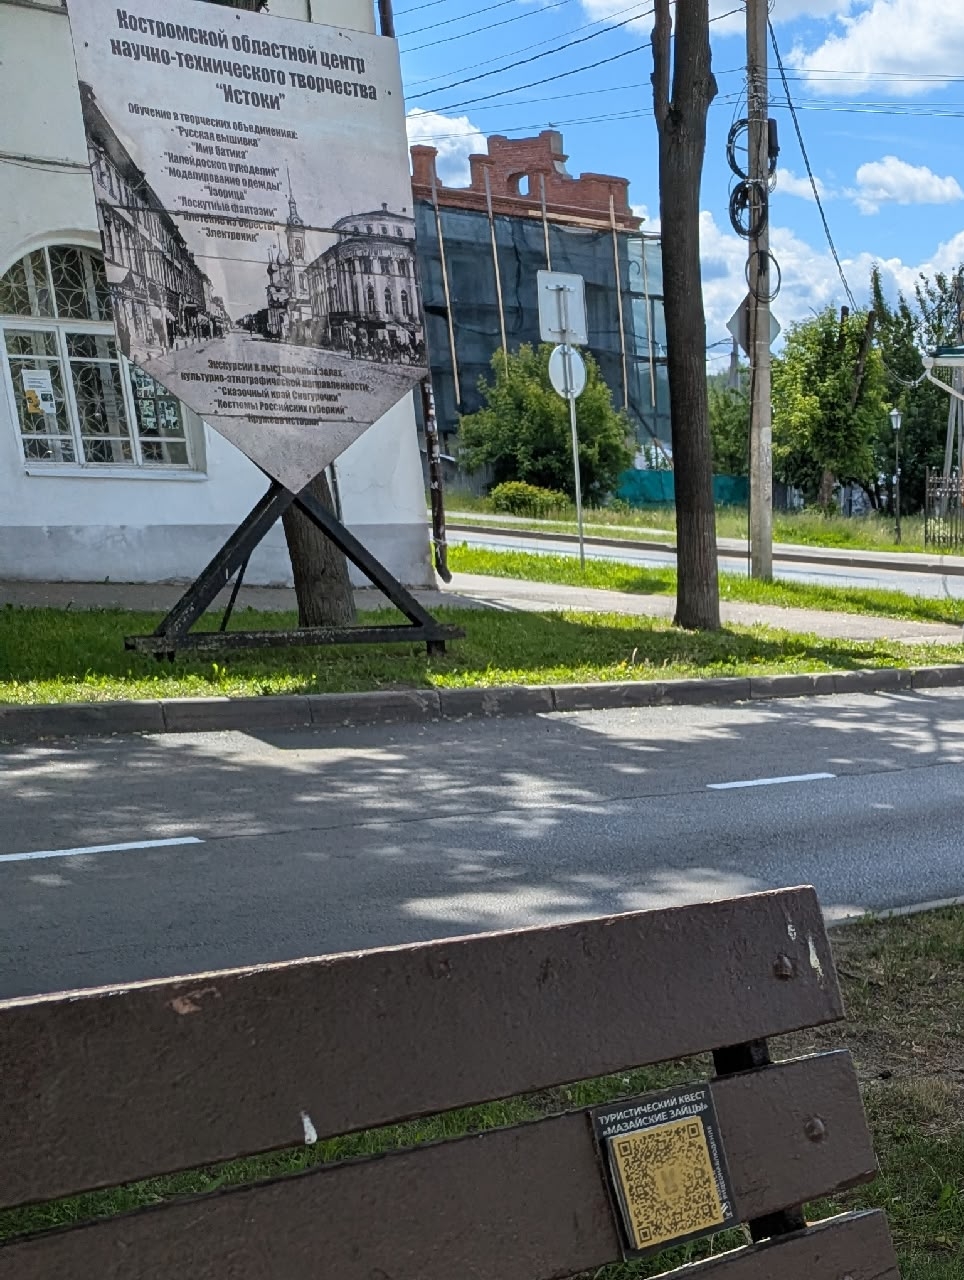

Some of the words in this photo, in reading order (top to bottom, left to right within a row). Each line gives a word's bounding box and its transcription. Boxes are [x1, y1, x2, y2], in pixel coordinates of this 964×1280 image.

[117, 9, 229, 49] Костромской
[231, 34, 317, 65] областной
[320, 51, 365, 74] центр
[110, 39, 286, 85] научно-технического
[289, 72, 377, 100] творчества
[128, 102, 171, 120] Обучение
[173, 112, 179, 120] в
[180, 113, 231, 129] творческих
[598, 1096, 678, 1125] ТУРИСТИЧЕСКИЙ
[678, 1090, 706, 1103] КВЕСТ
